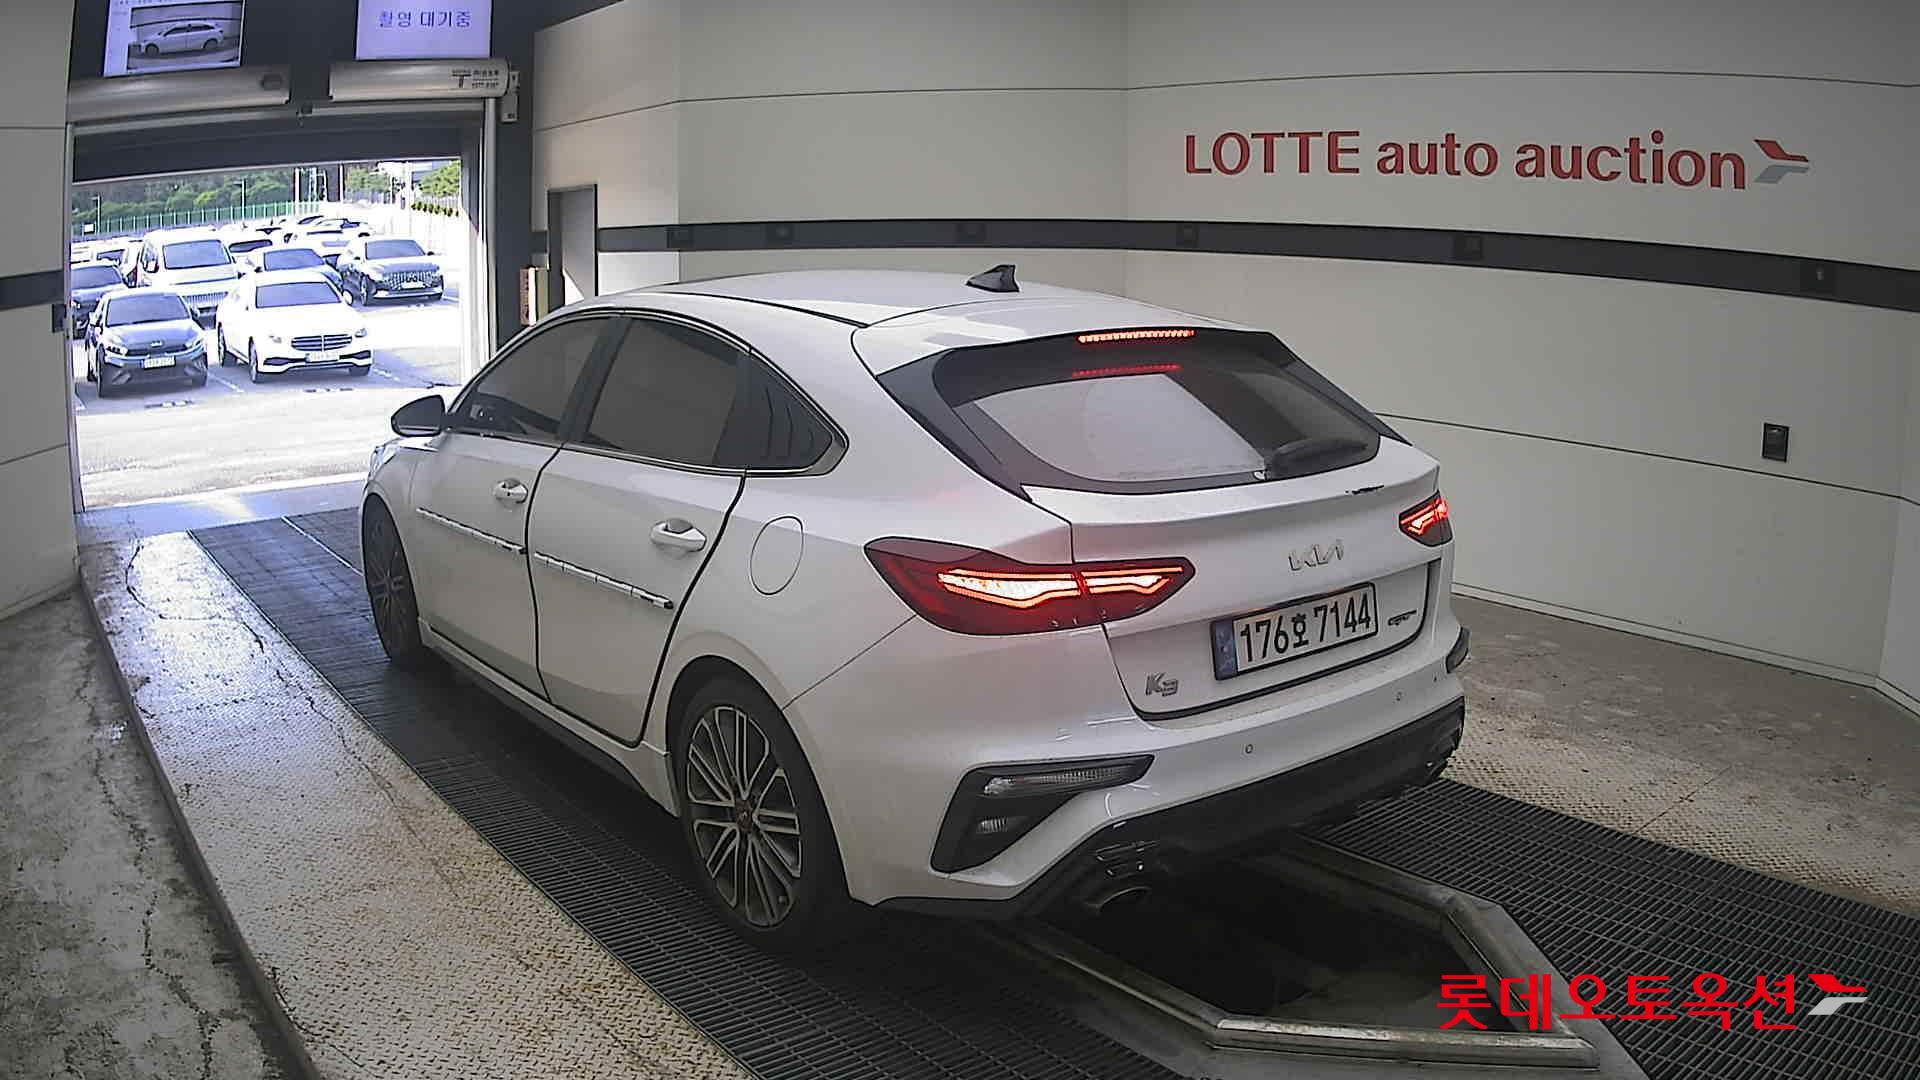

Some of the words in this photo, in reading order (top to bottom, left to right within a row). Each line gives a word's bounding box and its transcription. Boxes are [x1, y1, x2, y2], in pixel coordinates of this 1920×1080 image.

[419, 10, 471, 28] 대기중
[1185, 131, 1360, 176] LOTTE
[1377, 134, 1499, 176] auto
[1515, 131, 1745, 188] auction
